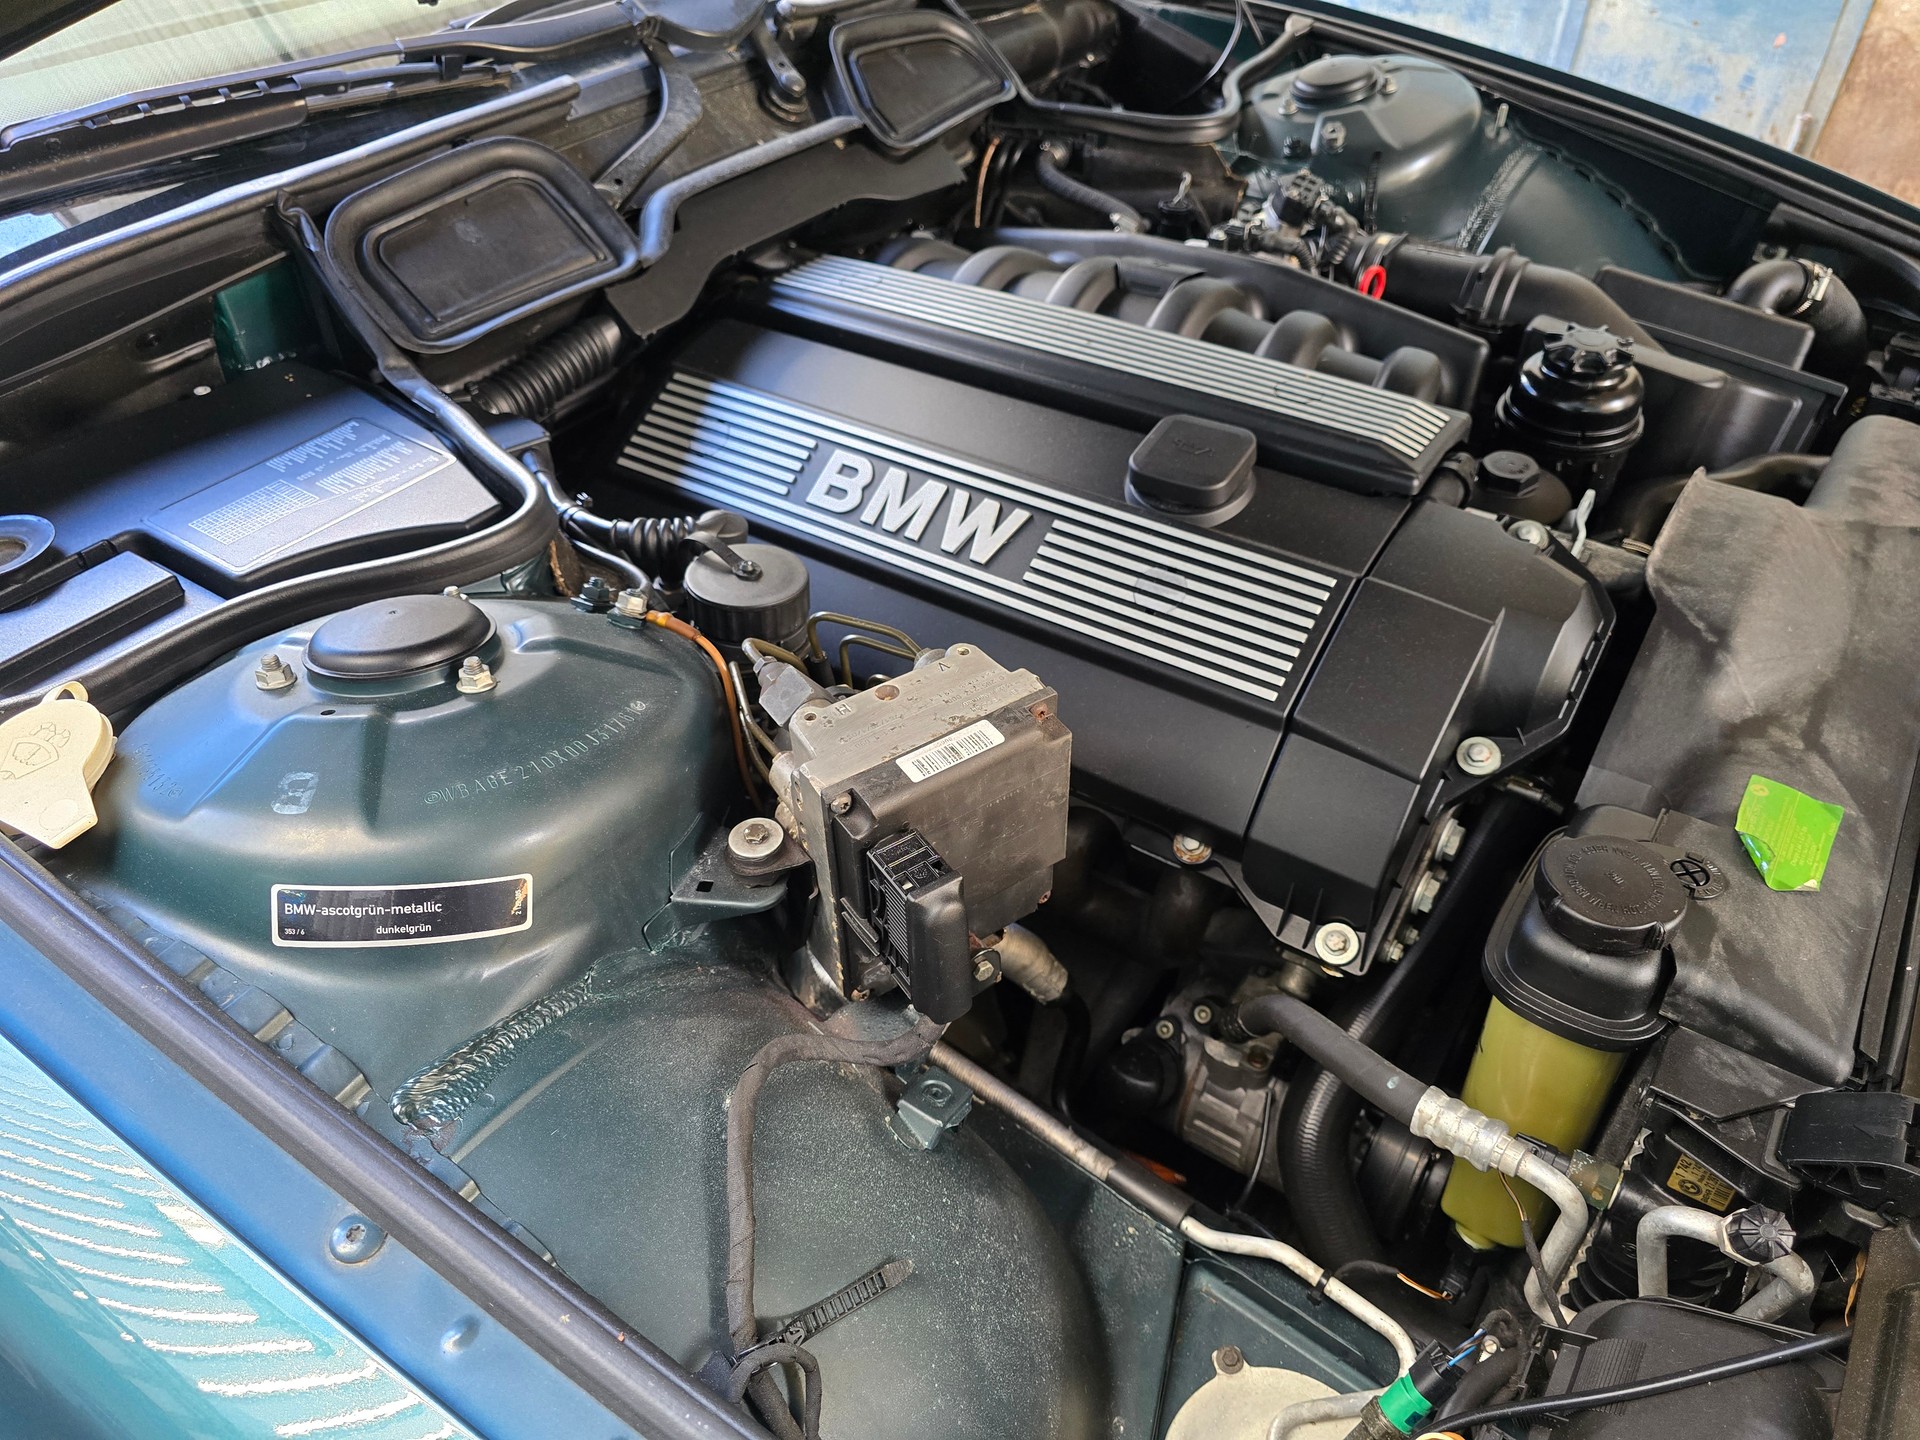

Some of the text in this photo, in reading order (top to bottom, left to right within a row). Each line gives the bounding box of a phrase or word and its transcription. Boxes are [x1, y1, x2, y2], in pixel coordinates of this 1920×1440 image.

[806, 449, 1034, 566] BMW
[284, 901, 443, 919] BMW-ascotgrün-metallic
[284, 928, 296, 936] 353
[376, 923, 432, 935] dunkelgrün
